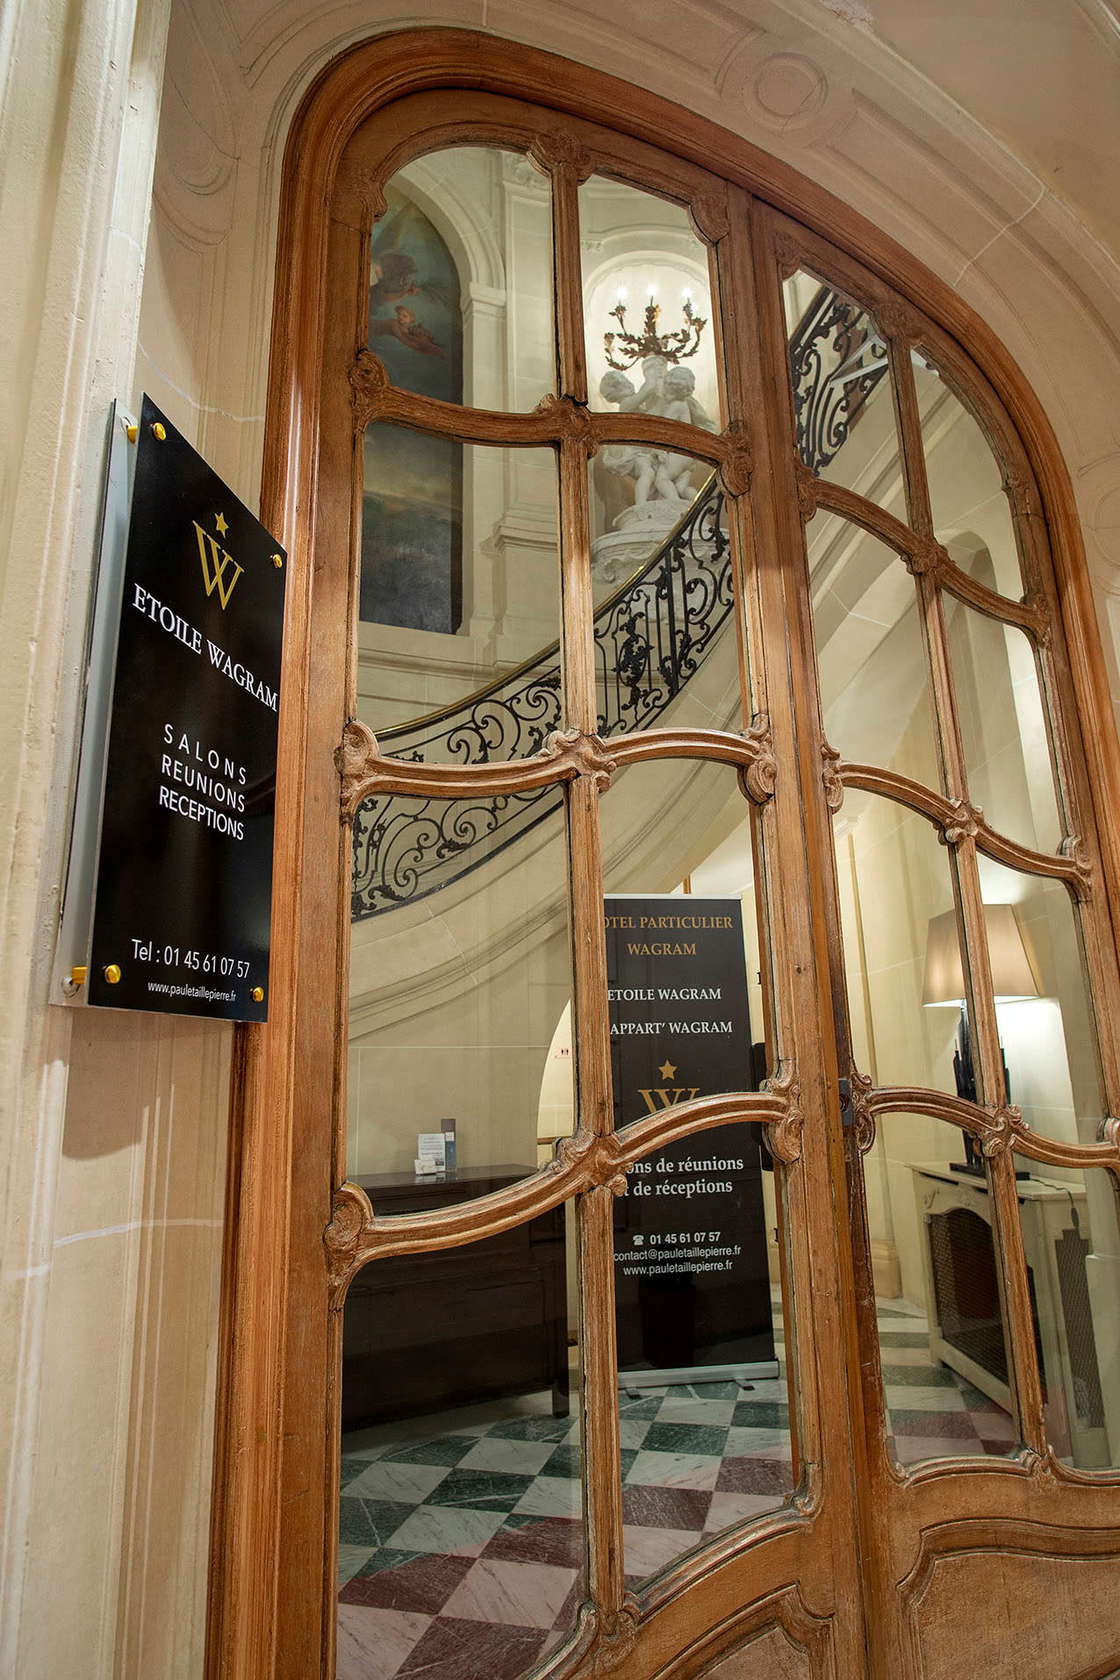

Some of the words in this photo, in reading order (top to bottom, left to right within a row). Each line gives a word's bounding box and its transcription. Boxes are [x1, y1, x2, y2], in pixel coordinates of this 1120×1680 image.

[132, 582, 202, 655] ETOILE
[206, 639, 279, 713] WAGRAM
[163, 723, 247, 785] SALONS
[161, 753, 246, 813] REUNIONS
[159, 785, 244, 841] RECEPTIONS
[640, 916, 734, 929] PARTICULIER
[626, 943, 697, 956] WAGRAM
[163, 945, 179, 967] 01
[184, 950, 200, 970] 45
[202, 953, 216, 973] 61
[220, 956, 235, 976] 07
[236, 960, 250, 979] 57
[147, 981, 237, 1002] www.pauletaillepierre.fr
[607, 988, 655, 1001] ETOILE
[658, 988, 721, 1001] WAGRAM
[669, 1021, 733, 1034] WAGRAM
[656, 1157, 674, 1173] de
[678, 1156, 745, 1172] réunions
[633, 1181, 652, 1196] de
[655, 1179, 734, 1199] réceptions
[650, 1234, 661, 1245] 01
[665, 1233, 677, 1244] 45
[680, 1232, 691, 1243] 61
[694, 1231, 706, 1243] 07
[709, 1231, 721, 1242] 57
[613, 1244, 742, 1262] contact@pauletaillepierre.fr
[623, 1259, 733, 1277] www.pauletaillepierre.fr
